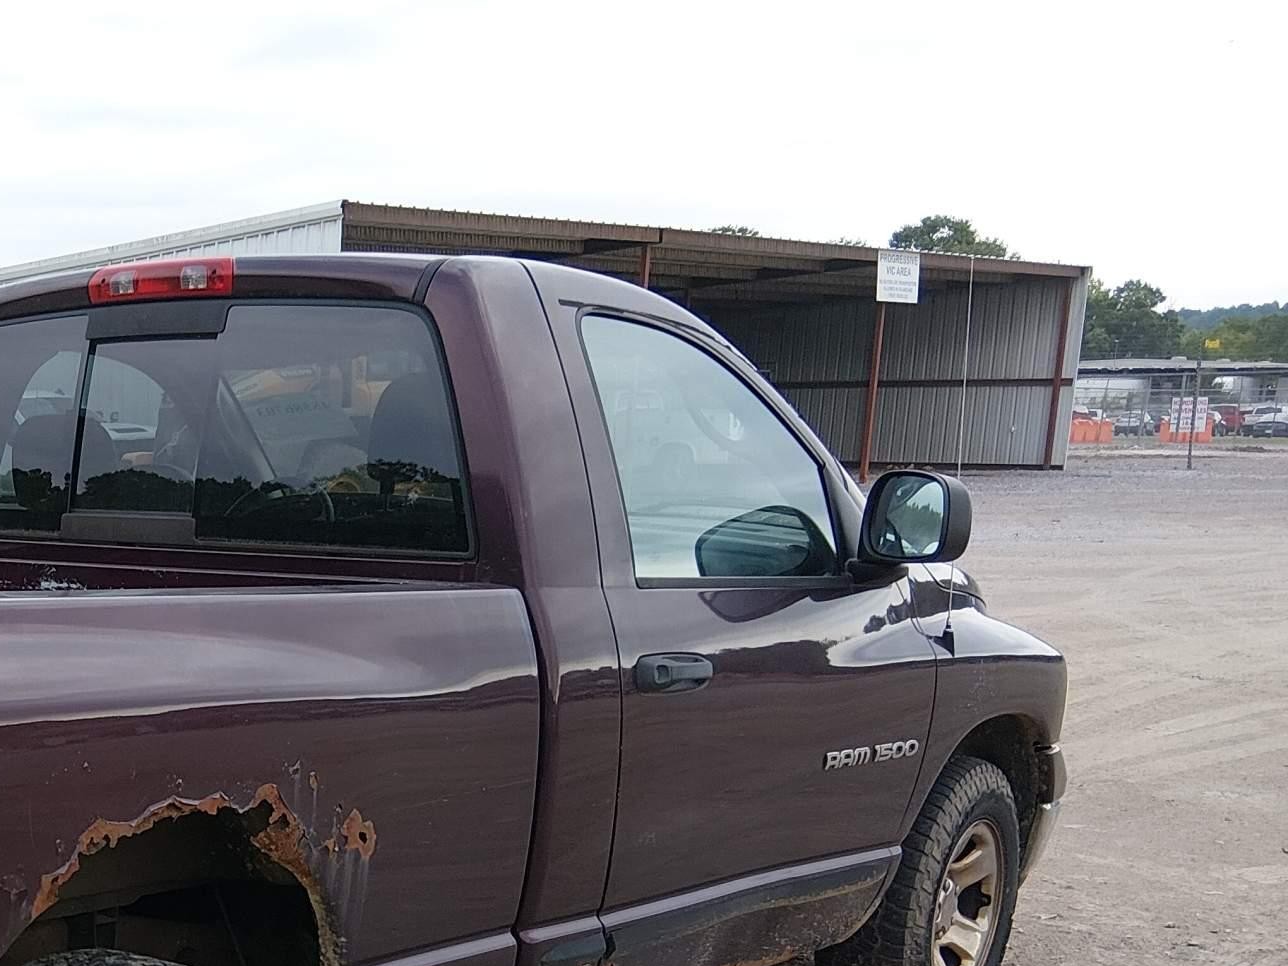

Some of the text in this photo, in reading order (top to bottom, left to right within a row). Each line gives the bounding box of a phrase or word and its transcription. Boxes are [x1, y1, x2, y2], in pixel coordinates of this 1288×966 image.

[880, 253, 919, 266] PROGRESSIVE
[886, 265, 911, 277] VIC AREA
[824, 739, 919, 770] RAM 1500
